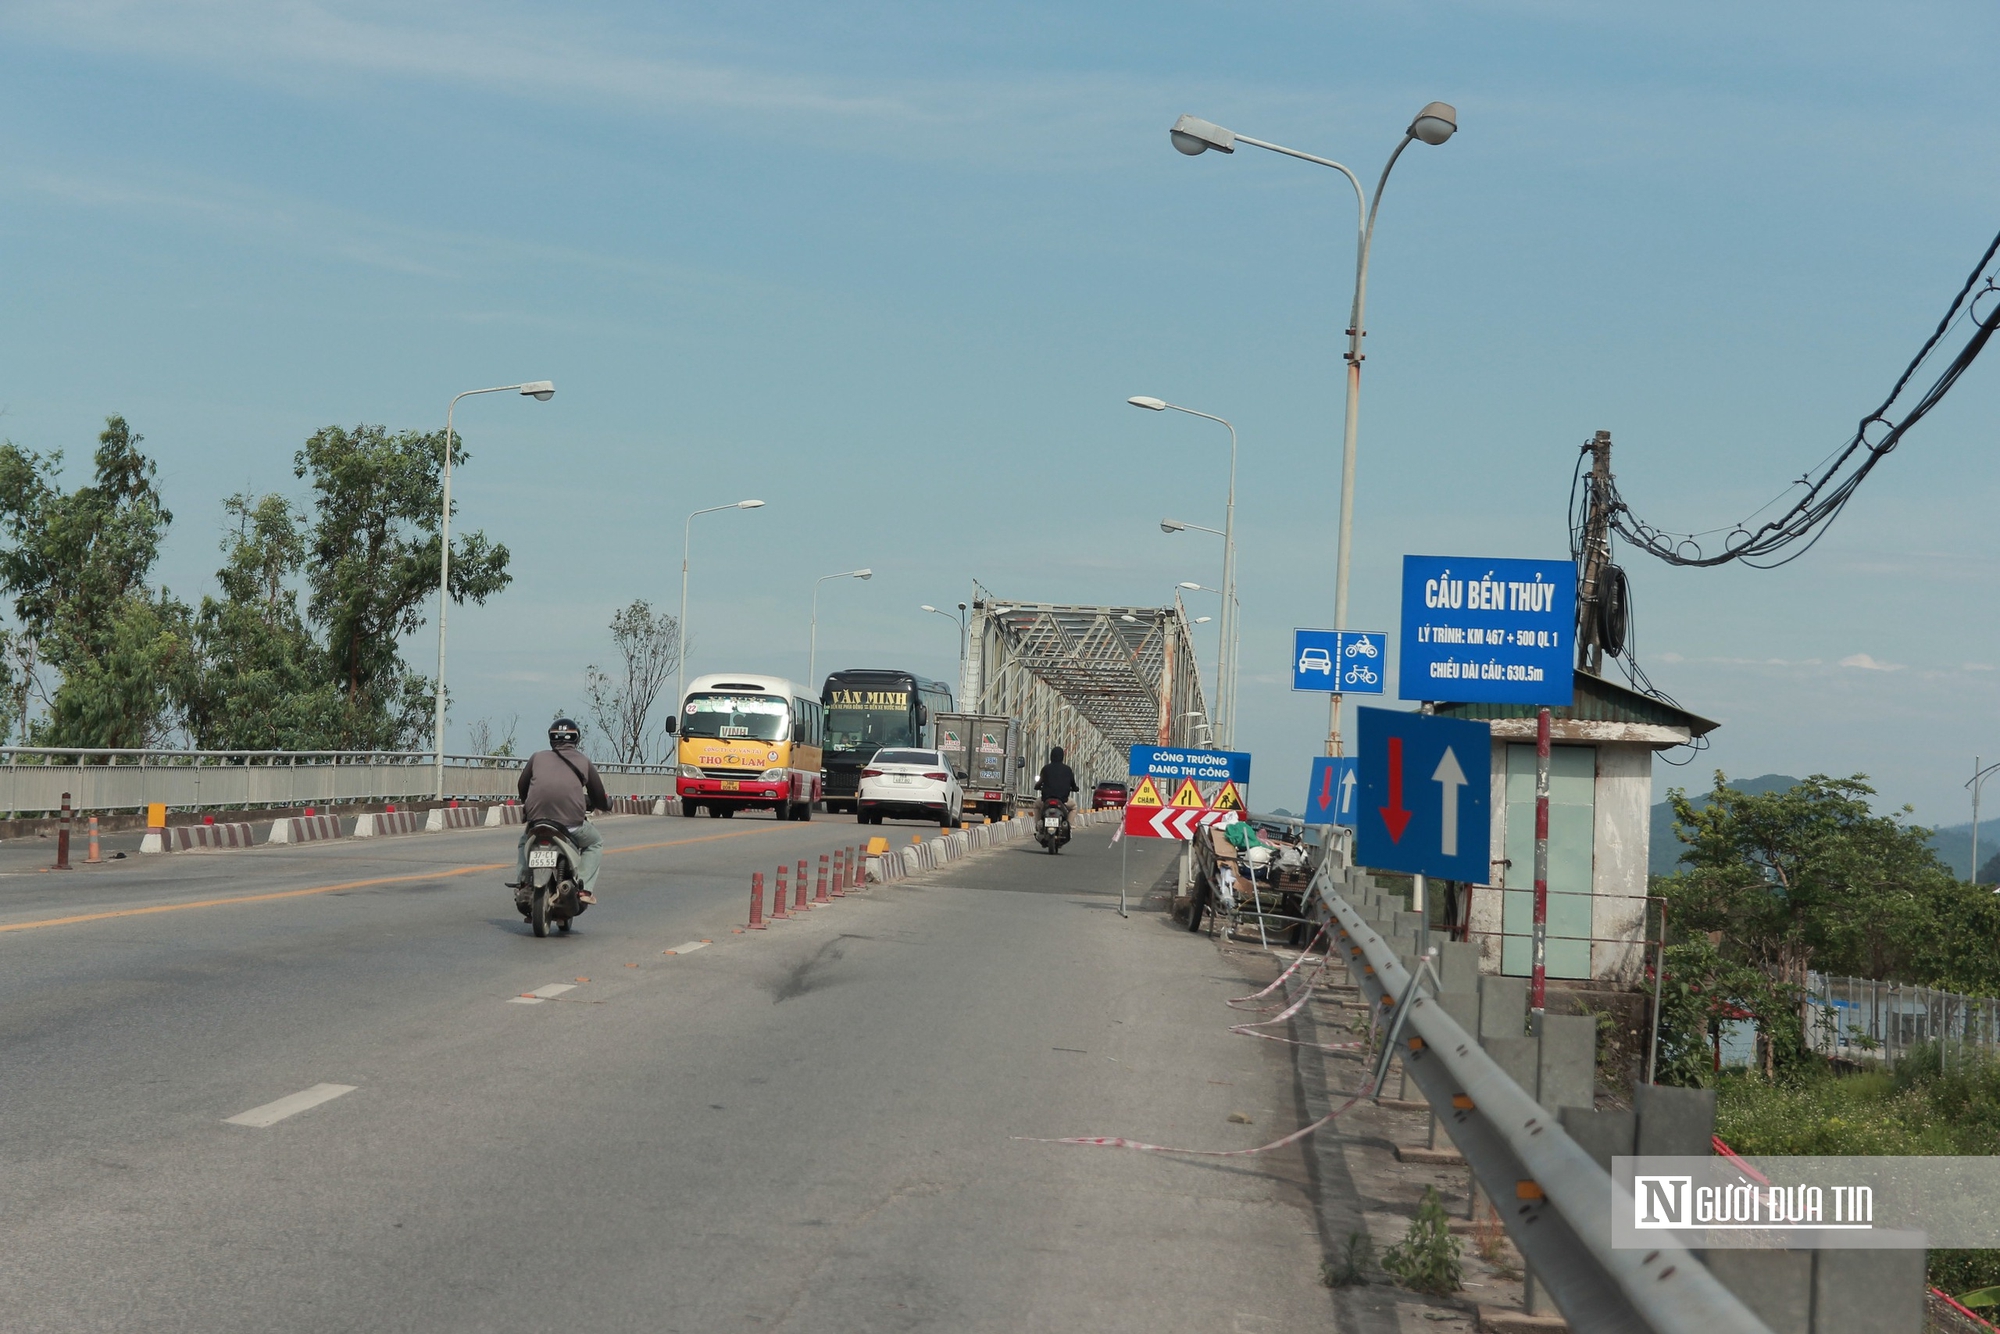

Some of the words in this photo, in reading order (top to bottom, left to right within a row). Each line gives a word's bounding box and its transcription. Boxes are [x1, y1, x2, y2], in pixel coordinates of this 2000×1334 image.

[1425, 569, 1463, 609] CẦU
[1467, 570, 1505, 610] BẾN
[1508, 572, 1555, 612] THỦY
[1418, 623, 1431, 643] LÝ
[1432, 624, 1466, 644] TRÌNH:
[1467, 628, 1484, 645] KM
[1485, 629, 1505, 646] 467
[1507, 633, 1515, 645] +
[1516, 630, 1535, 647] 500
[1537, 631, 1551, 648] QL
[1552, 632, 1558, 647] 1
[1430, 656, 1460, 679] CHIỀU
[1461, 660, 1479, 680] DÀI
[1481, 658, 1506, 680] CẦU:
[1506, 665, 1544, 682] 630.5m
[831, 689, 863, 704] VĂN
[865, 691, 908, 705] MINH
[687, 705, 697, 713] 22
[722, 727, 747, 737] VINH
[1152, 751, 1184, 763] CÔNG
[1186, 754, 1228, 766] TRƯỜNG
[1148, 764, 1179, 775] ĐANG
[1181, 766, 1197, 776] THI
[1198, 767, 1230, 778] CÔNG
